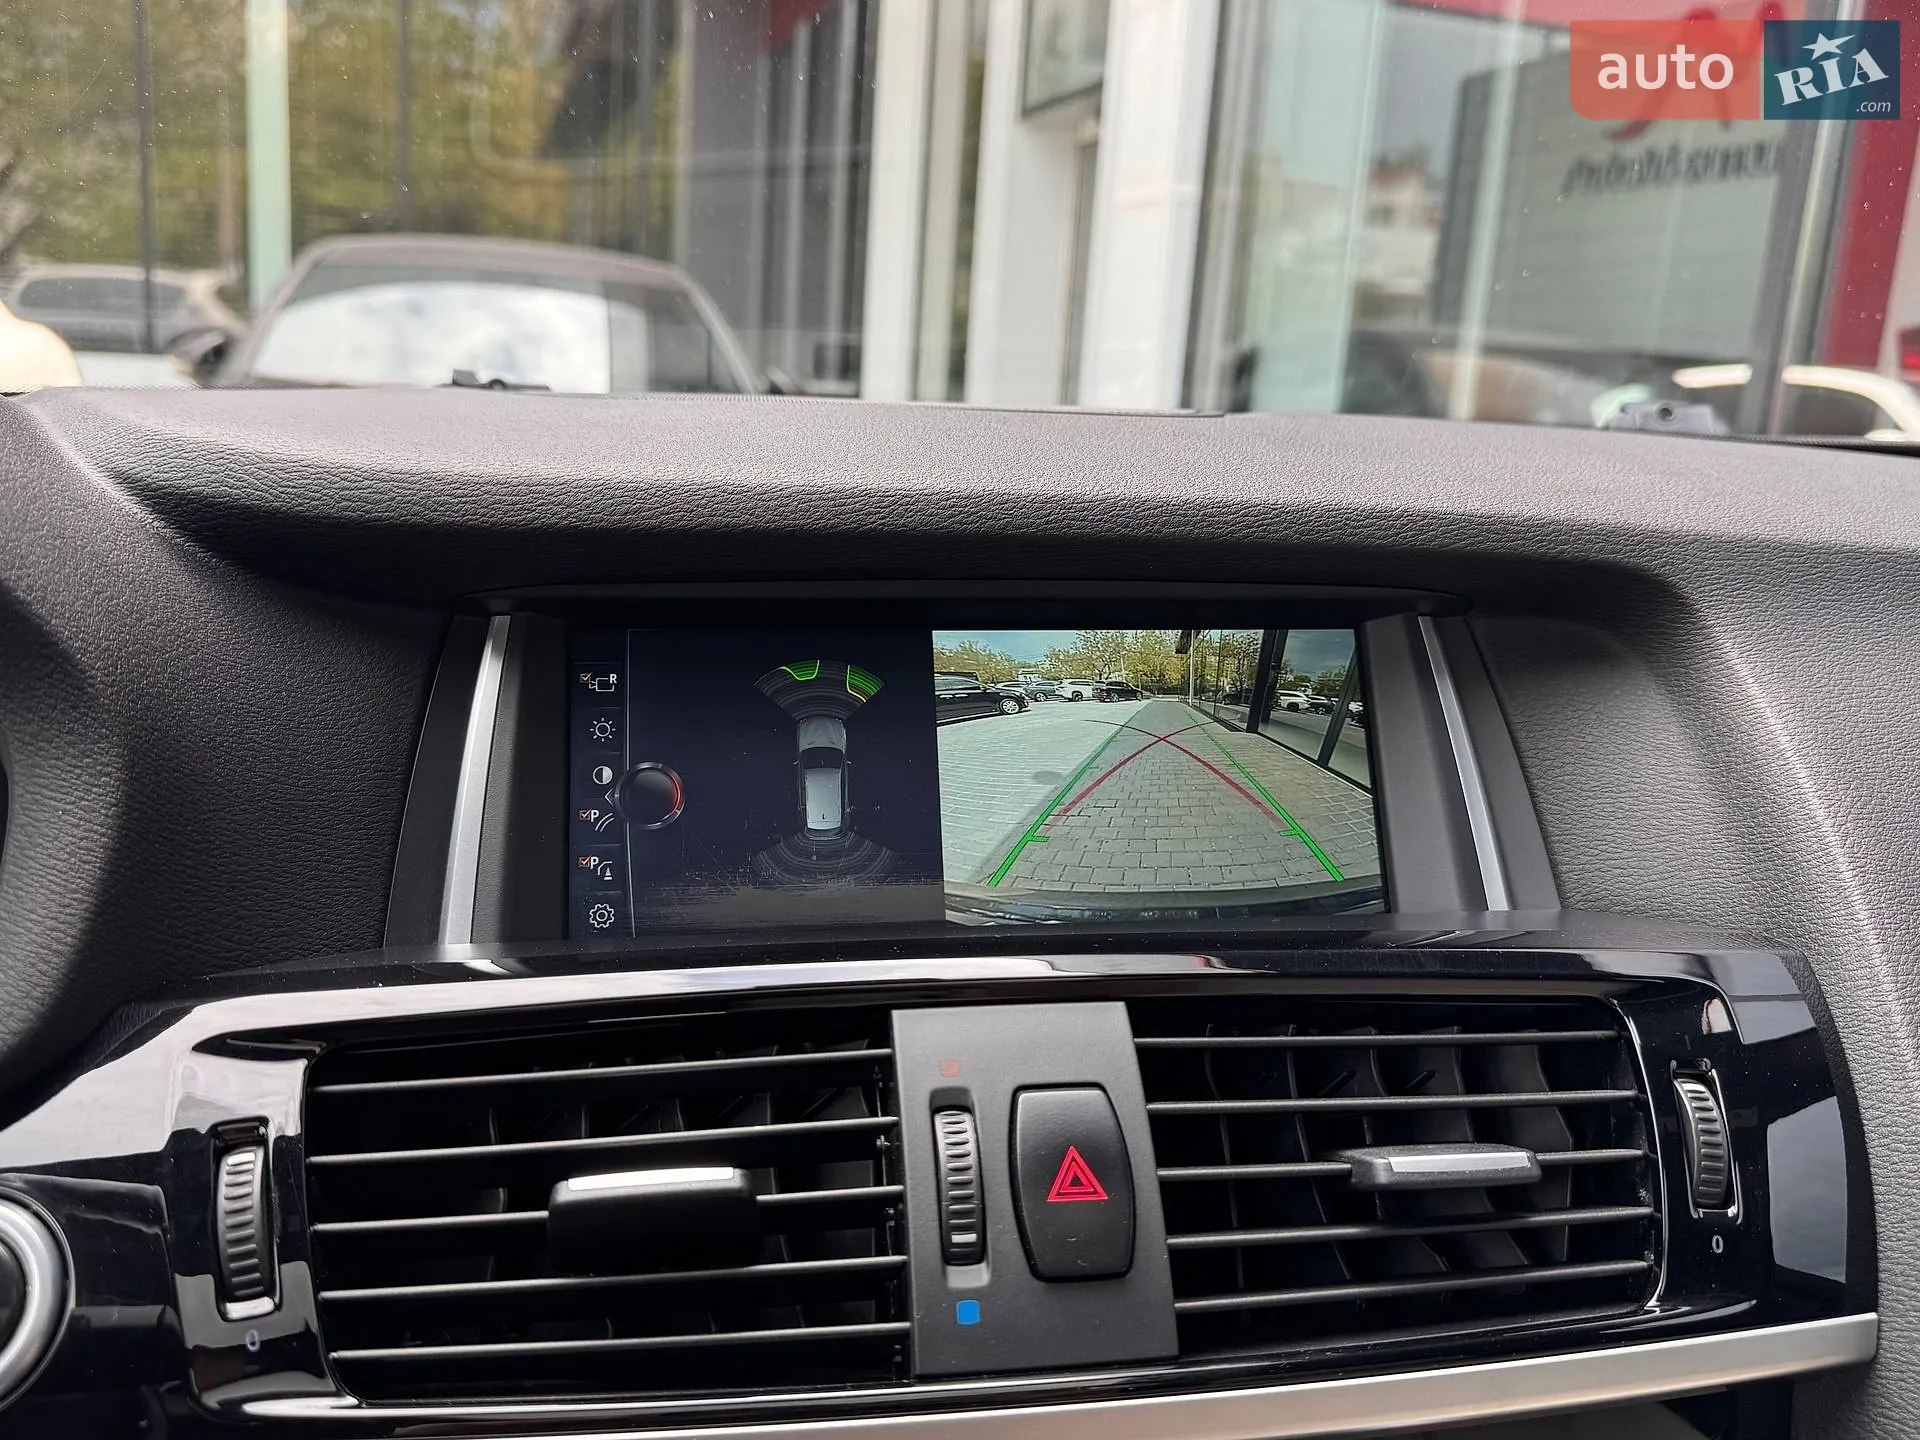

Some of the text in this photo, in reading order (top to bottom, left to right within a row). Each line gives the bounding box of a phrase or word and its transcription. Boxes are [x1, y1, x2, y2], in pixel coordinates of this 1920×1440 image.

[609, 673, 618, 684] R
[590, 809, 600, 822] P
[590, 856, 600, 870] P
[1711, 1235, 1724, 1253] 0
[247, 1330, 260, 1352] 0
